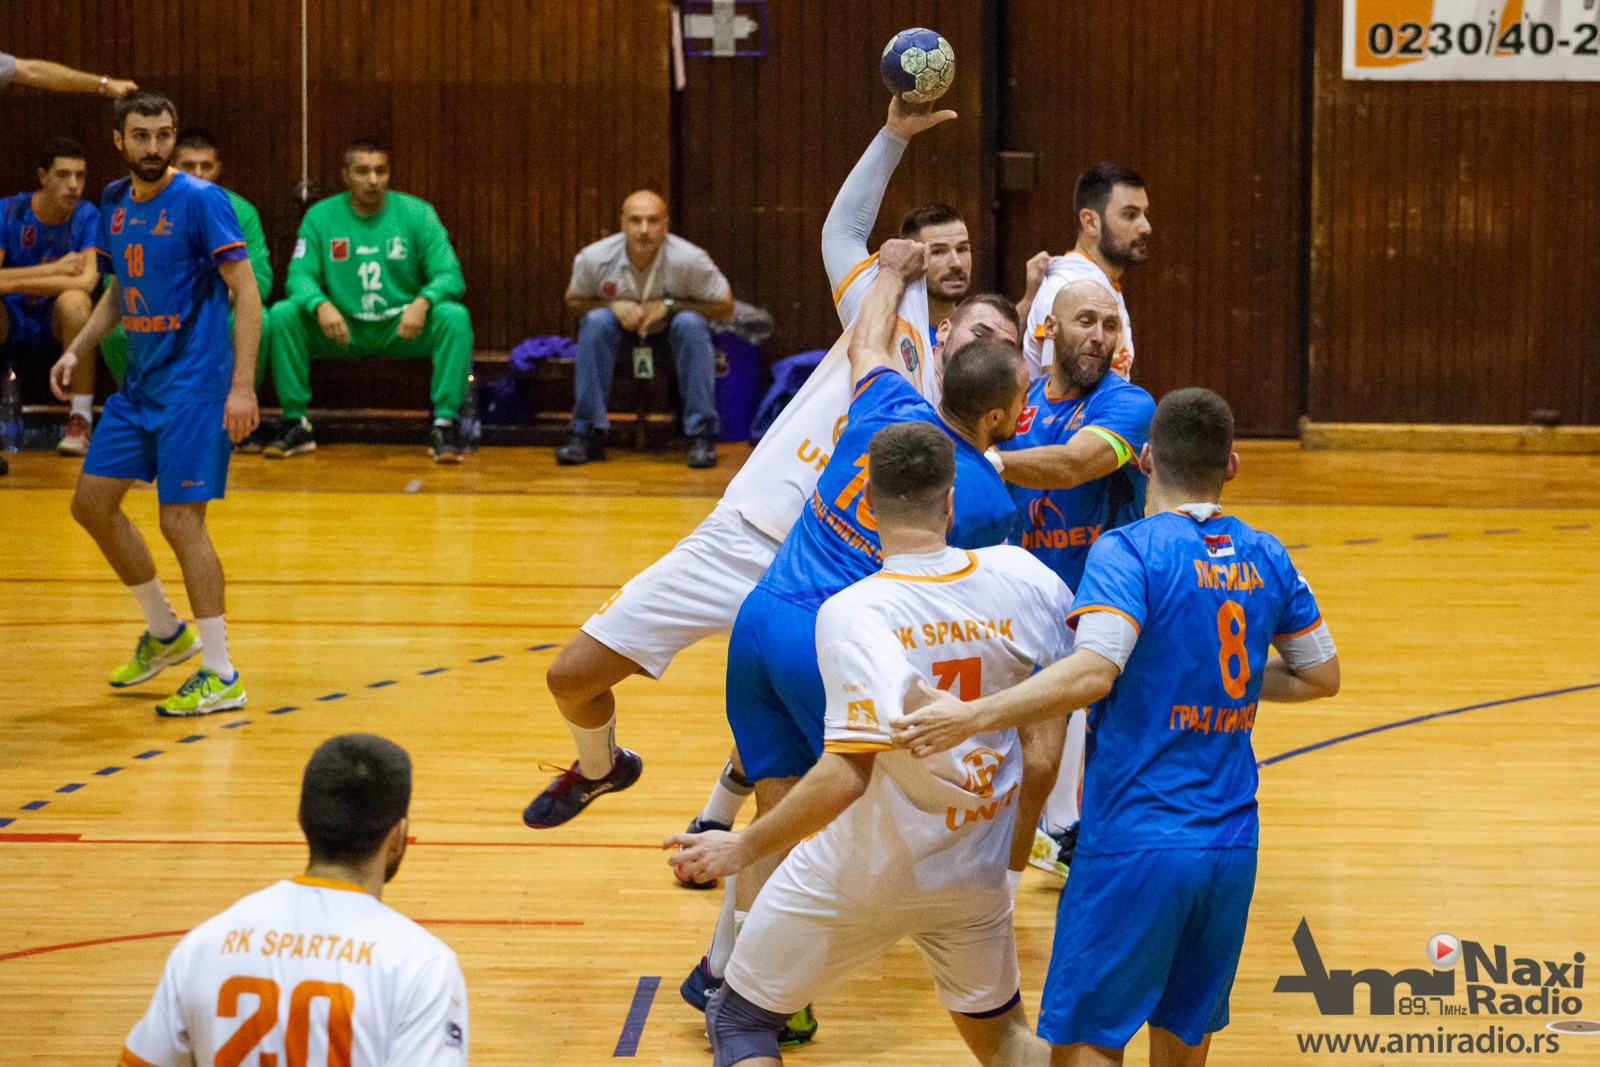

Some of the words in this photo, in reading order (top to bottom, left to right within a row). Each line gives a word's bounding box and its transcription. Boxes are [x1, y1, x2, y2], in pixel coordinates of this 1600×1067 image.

[123, 243, 145, 278] 18
[357, 260, 383, 291] 12
[1216, 599, 1251, 700] 8
[220, 928, 256, 955] RK
[260, 929, 378, 967] SPARTAK
[214, 974, 356, 1067] 20
